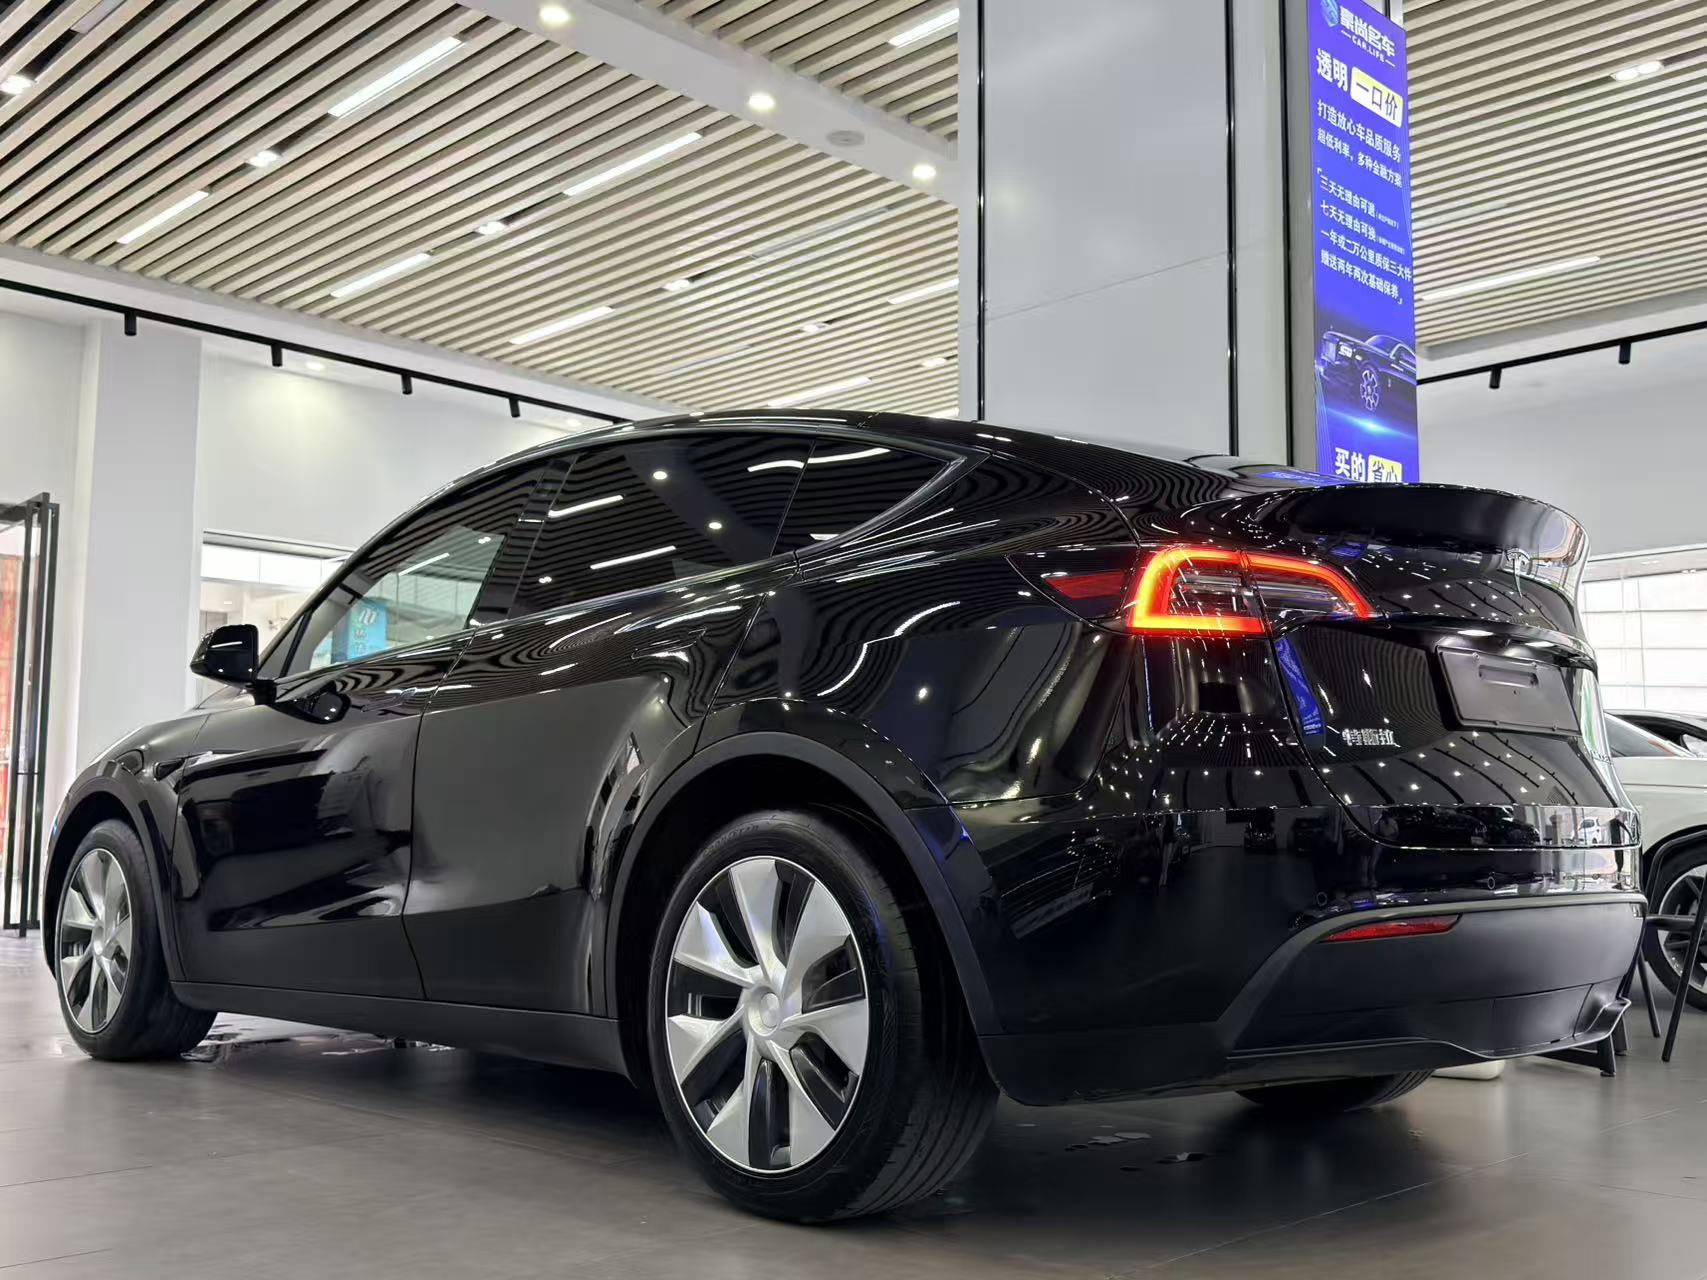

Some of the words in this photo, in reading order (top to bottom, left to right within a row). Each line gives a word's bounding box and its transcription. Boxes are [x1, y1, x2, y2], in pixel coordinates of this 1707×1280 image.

[1316, 48, 1348, 92] 透明
[1356, 82, 1398, 121] 一口价
[1317, 99, 1401, 163] 打造放心车品质服务
[1320, 200, 1377, 242] 七天无理由可换
[1321, 229, 1412, 282] 一年或二万公里质保三大件
[1335, 447, 1366, 483] 买的
[1373, 460, 1398, 483] 省心
[1342, 728, 1395, 746] 特斯拉
